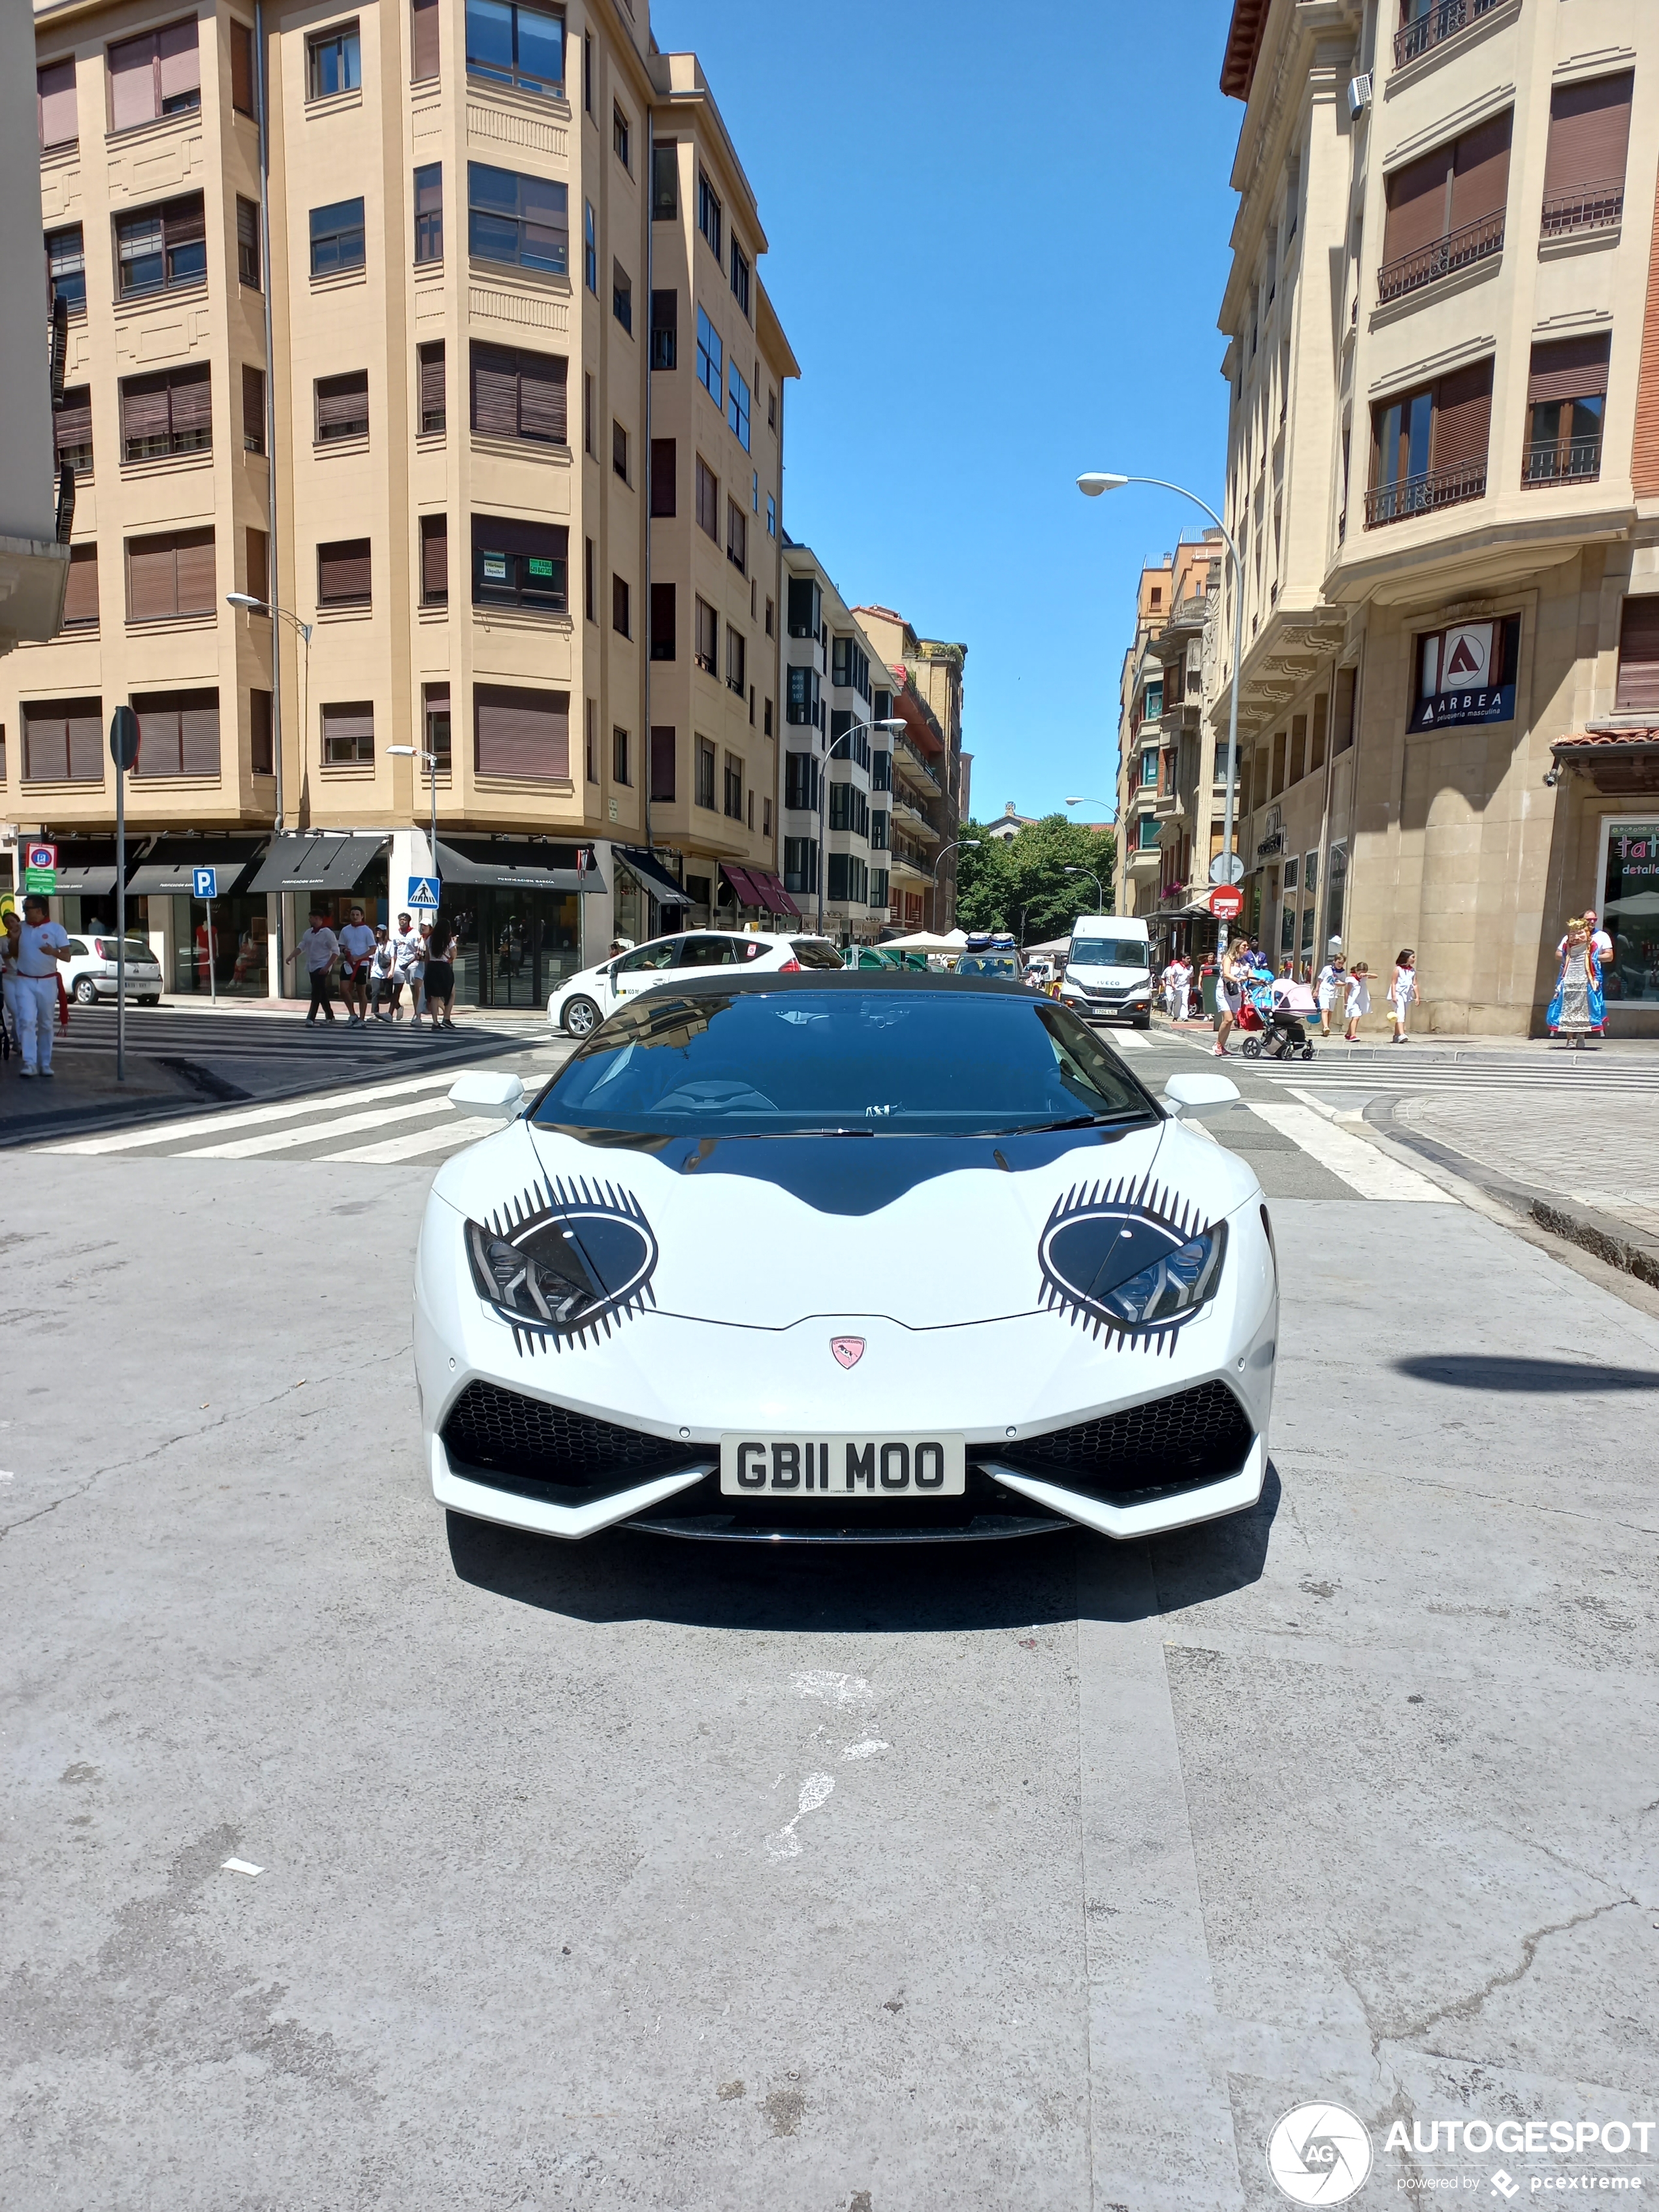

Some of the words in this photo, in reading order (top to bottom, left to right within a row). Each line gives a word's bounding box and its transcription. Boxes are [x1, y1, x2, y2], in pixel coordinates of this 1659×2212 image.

[1438, 693, 1501, 712] ARBEA
[1468, 708, 1500, 717] masculina
[197, 872, 210, 894] P
[737, 1442, 828, 1488] GB11
[846, 1442, 944, 1488] MOO
